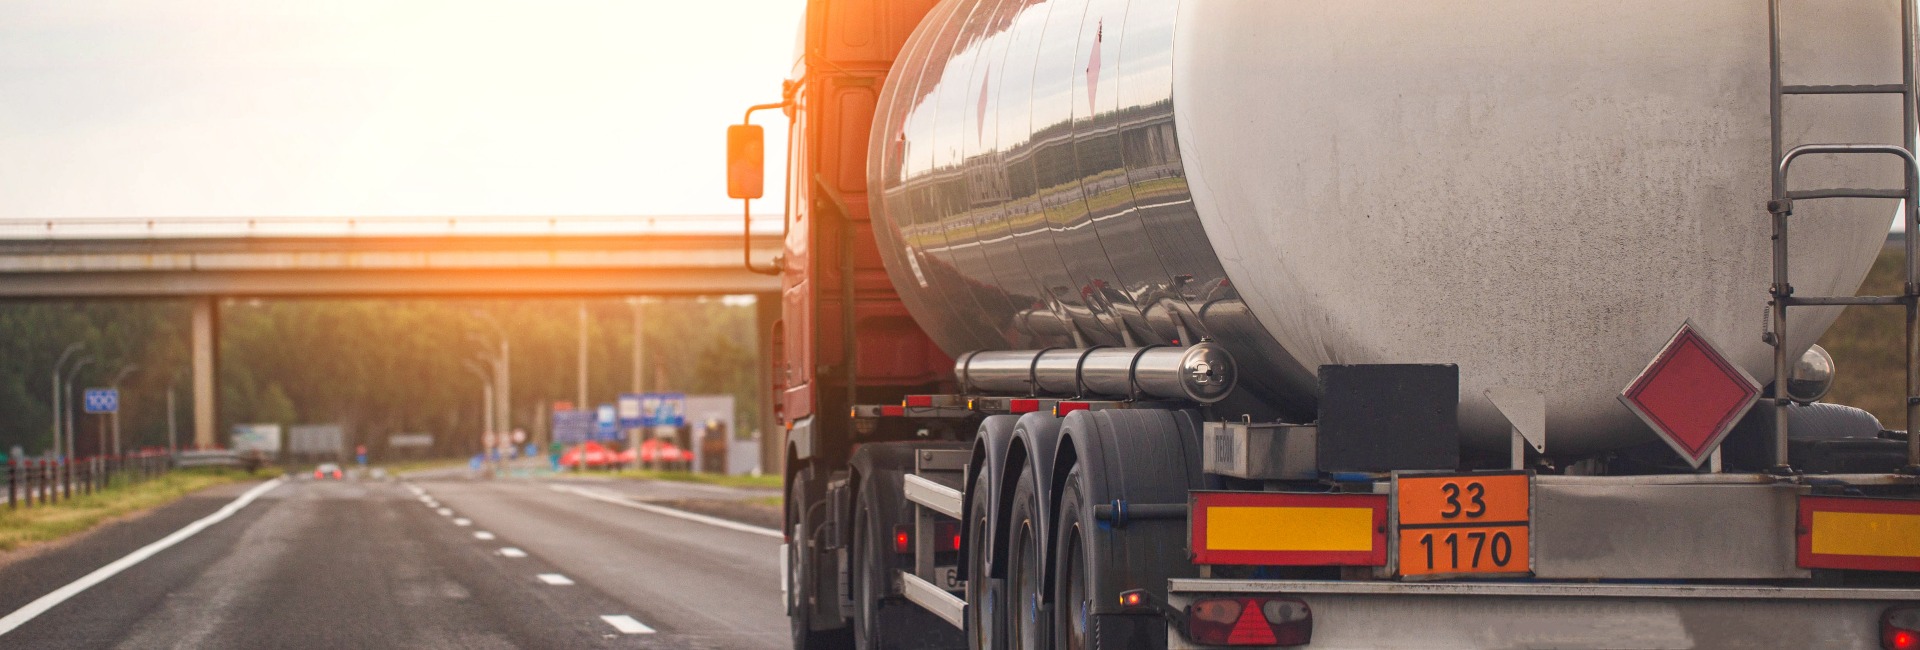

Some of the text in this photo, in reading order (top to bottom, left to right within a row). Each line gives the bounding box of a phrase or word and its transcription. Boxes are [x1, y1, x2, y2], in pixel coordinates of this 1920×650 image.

[88, 390, 117, 410] 100
[1441, 482, 1486, 519] 33
[1420, 531, 1511, 570] 1170
